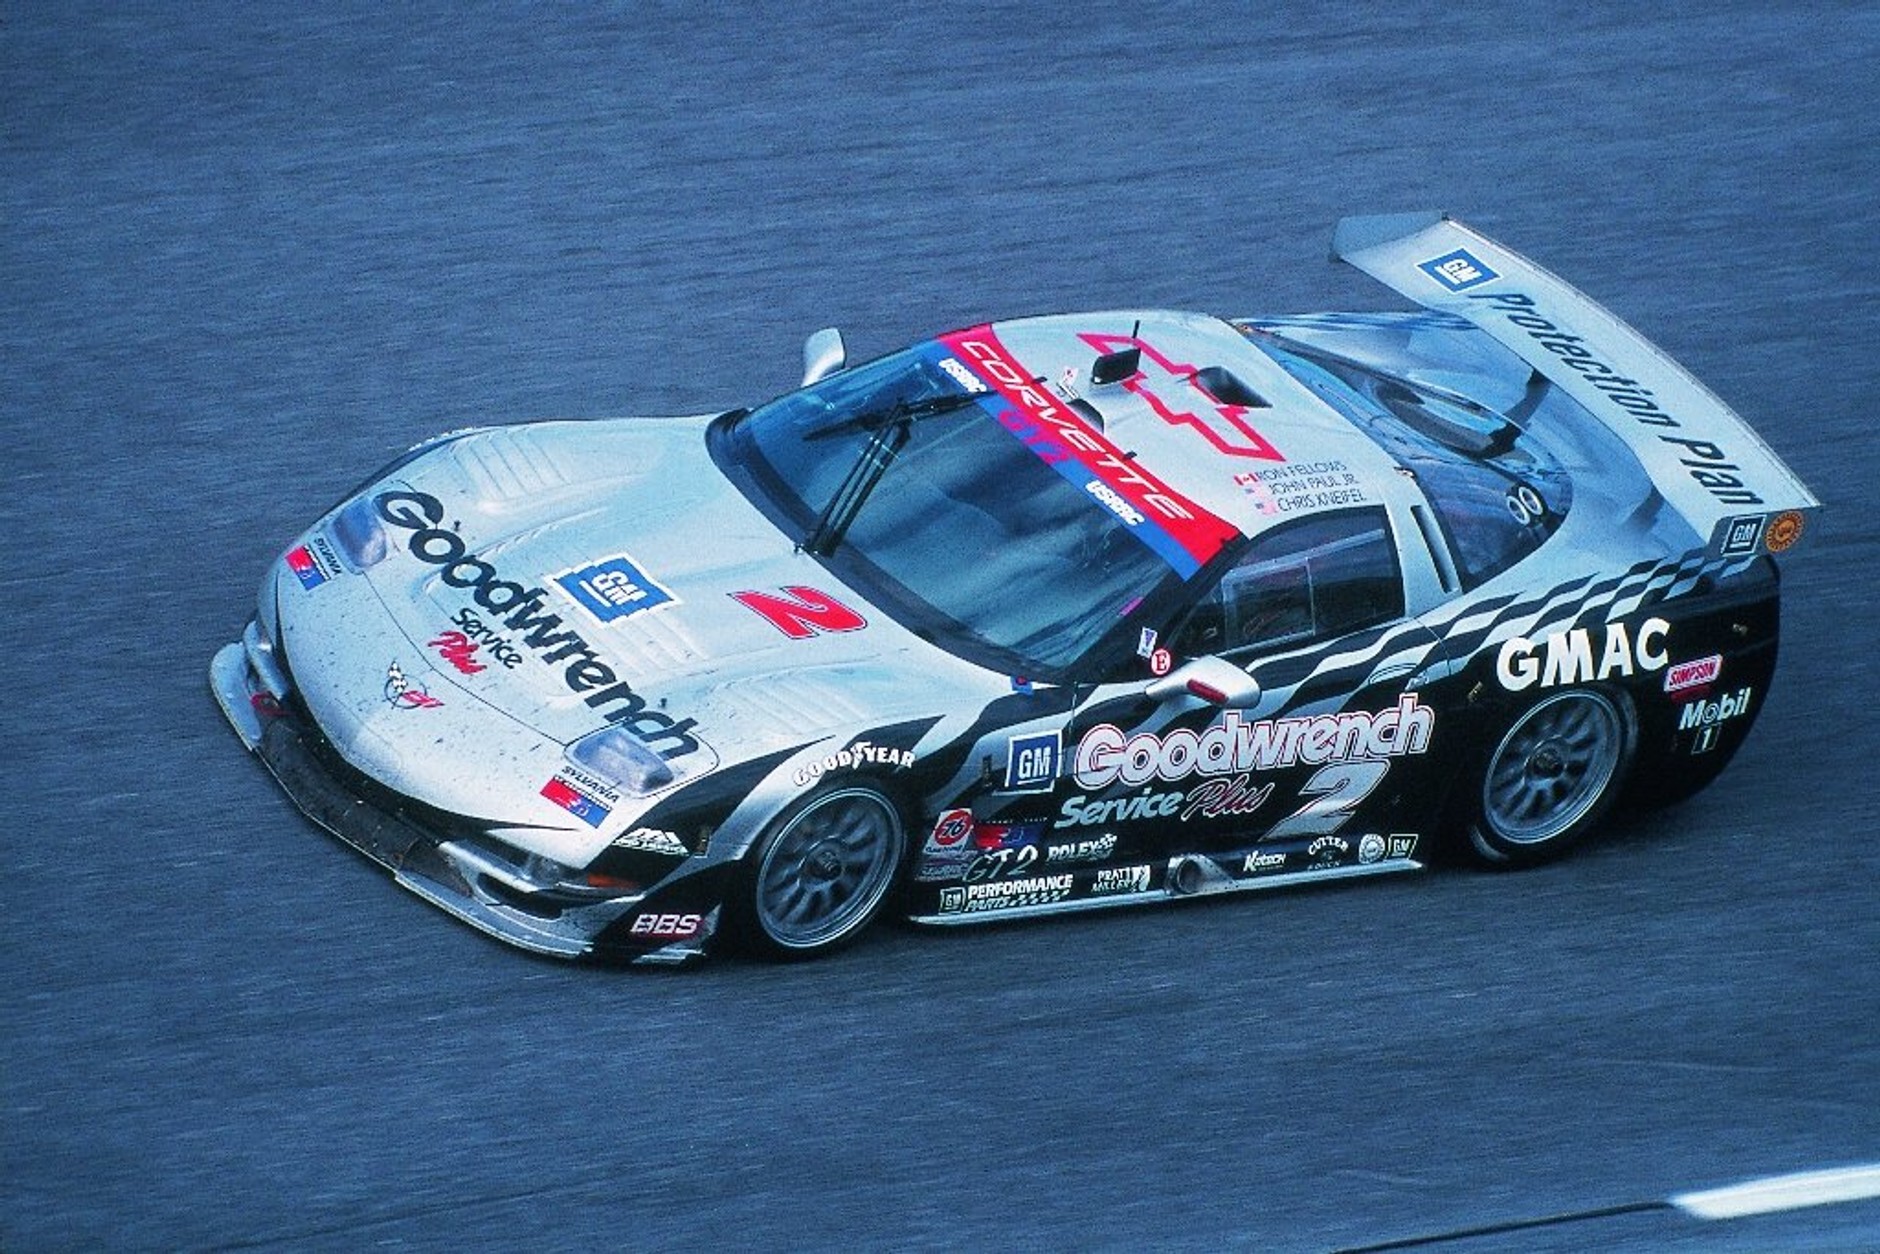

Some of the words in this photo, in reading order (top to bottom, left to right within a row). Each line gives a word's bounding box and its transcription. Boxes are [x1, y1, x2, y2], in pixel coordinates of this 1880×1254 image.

[1442, 258, 1484, 284] GM
[1468, 293, 1681, 427] Protection
[1659, 434, 1764, 505] Plan
[960, 341, 1195, 519] CORVETTE
[1268, 478, 1307, 495] JOHN
[1307, 474, 1341, 489] PAUL
[1287, 460, 1347, 477] FELLOWS
[1277, 493, 1316, 512] CHRIS
[1732, 522, 1758, 542] GM
[590, 570, 648, 606] GM
[373, 489, 699, 762] Goodwrench
[725, 585, 868, 640] 2
[449, 607, 523, 670] Service
[1496, 617, 1672, 692] GMAC
[1154, 651, 1168, 672] E
[1670, 661, 1716, 686] SIMPSON
[1678, 686, 1752, 731] Mobil
[1073, 692, 1436, 791] Goodwrench
[1702, 727, 1713, 751] 1
[792, 741, 917, 787] GOODYEAR
[1018, 747, 1053, 778] GM
[561, 765, 621, 804] SYLVANIA
[1256, 758, 1392, 843] 2
[1053, 787, 1185, 830] Service
[1180, 773, 1276, 822] Plus
[938, 819, 968, 839] 76
[1308, 835, 1349, 856] CUTTER
[967, 874, 1074, 899] PERFORMANCE
[630, 914, 702, 935] BBS
